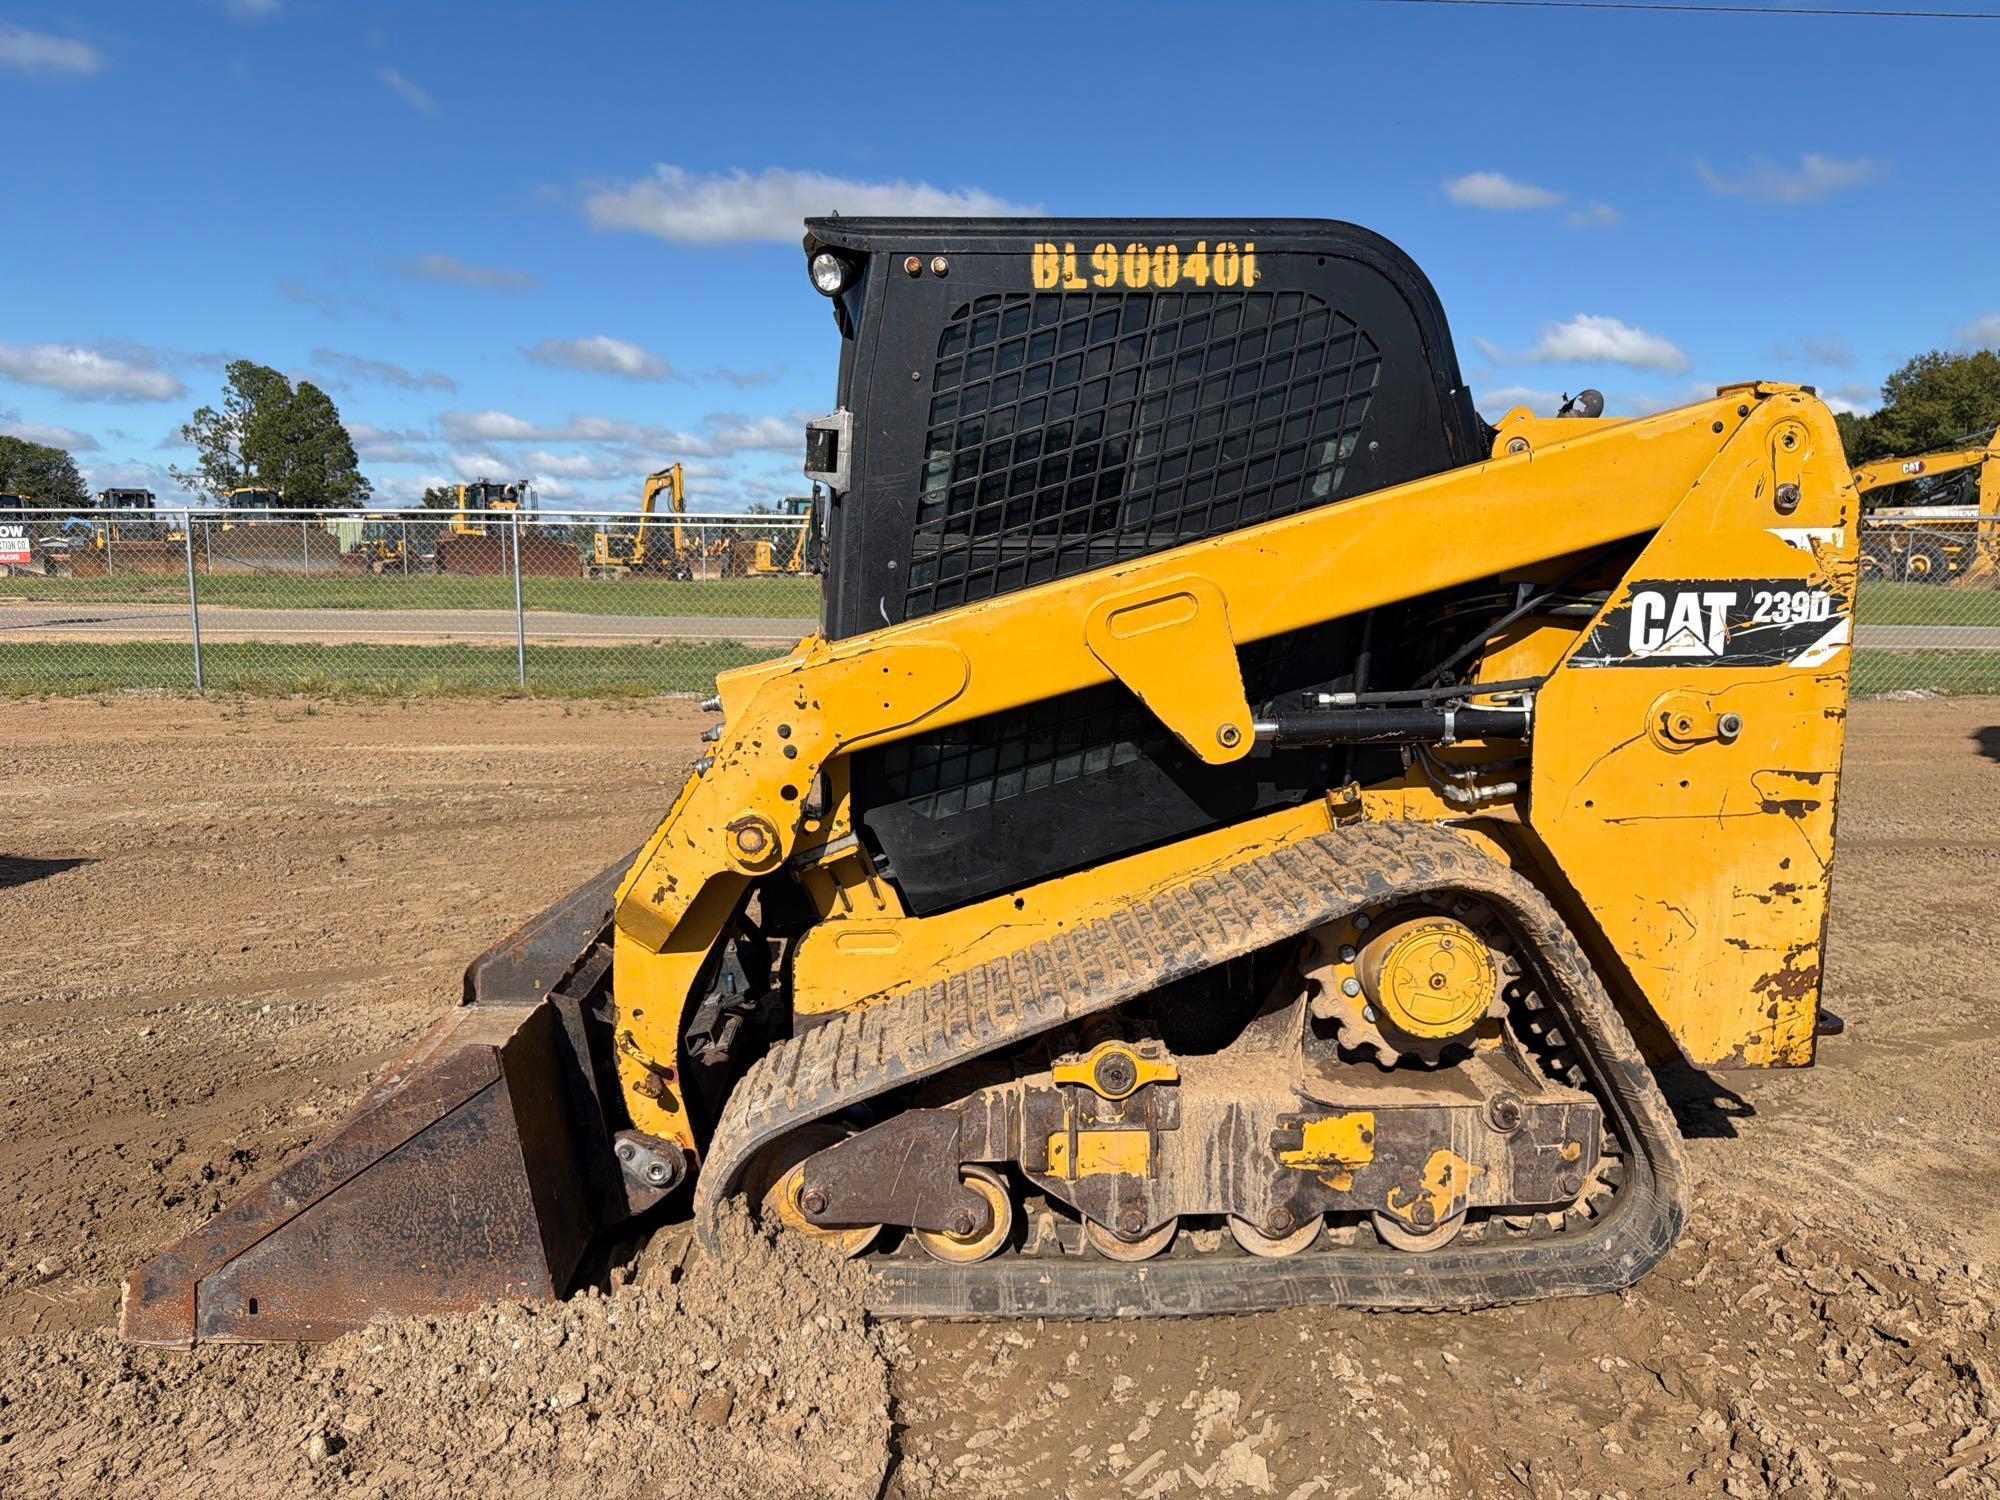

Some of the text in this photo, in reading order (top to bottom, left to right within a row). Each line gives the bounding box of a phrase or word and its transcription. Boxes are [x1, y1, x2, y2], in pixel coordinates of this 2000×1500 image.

[1902, 461, 1921, 475] CAT
[1629, 591, 1830, 656] CAT 239D
